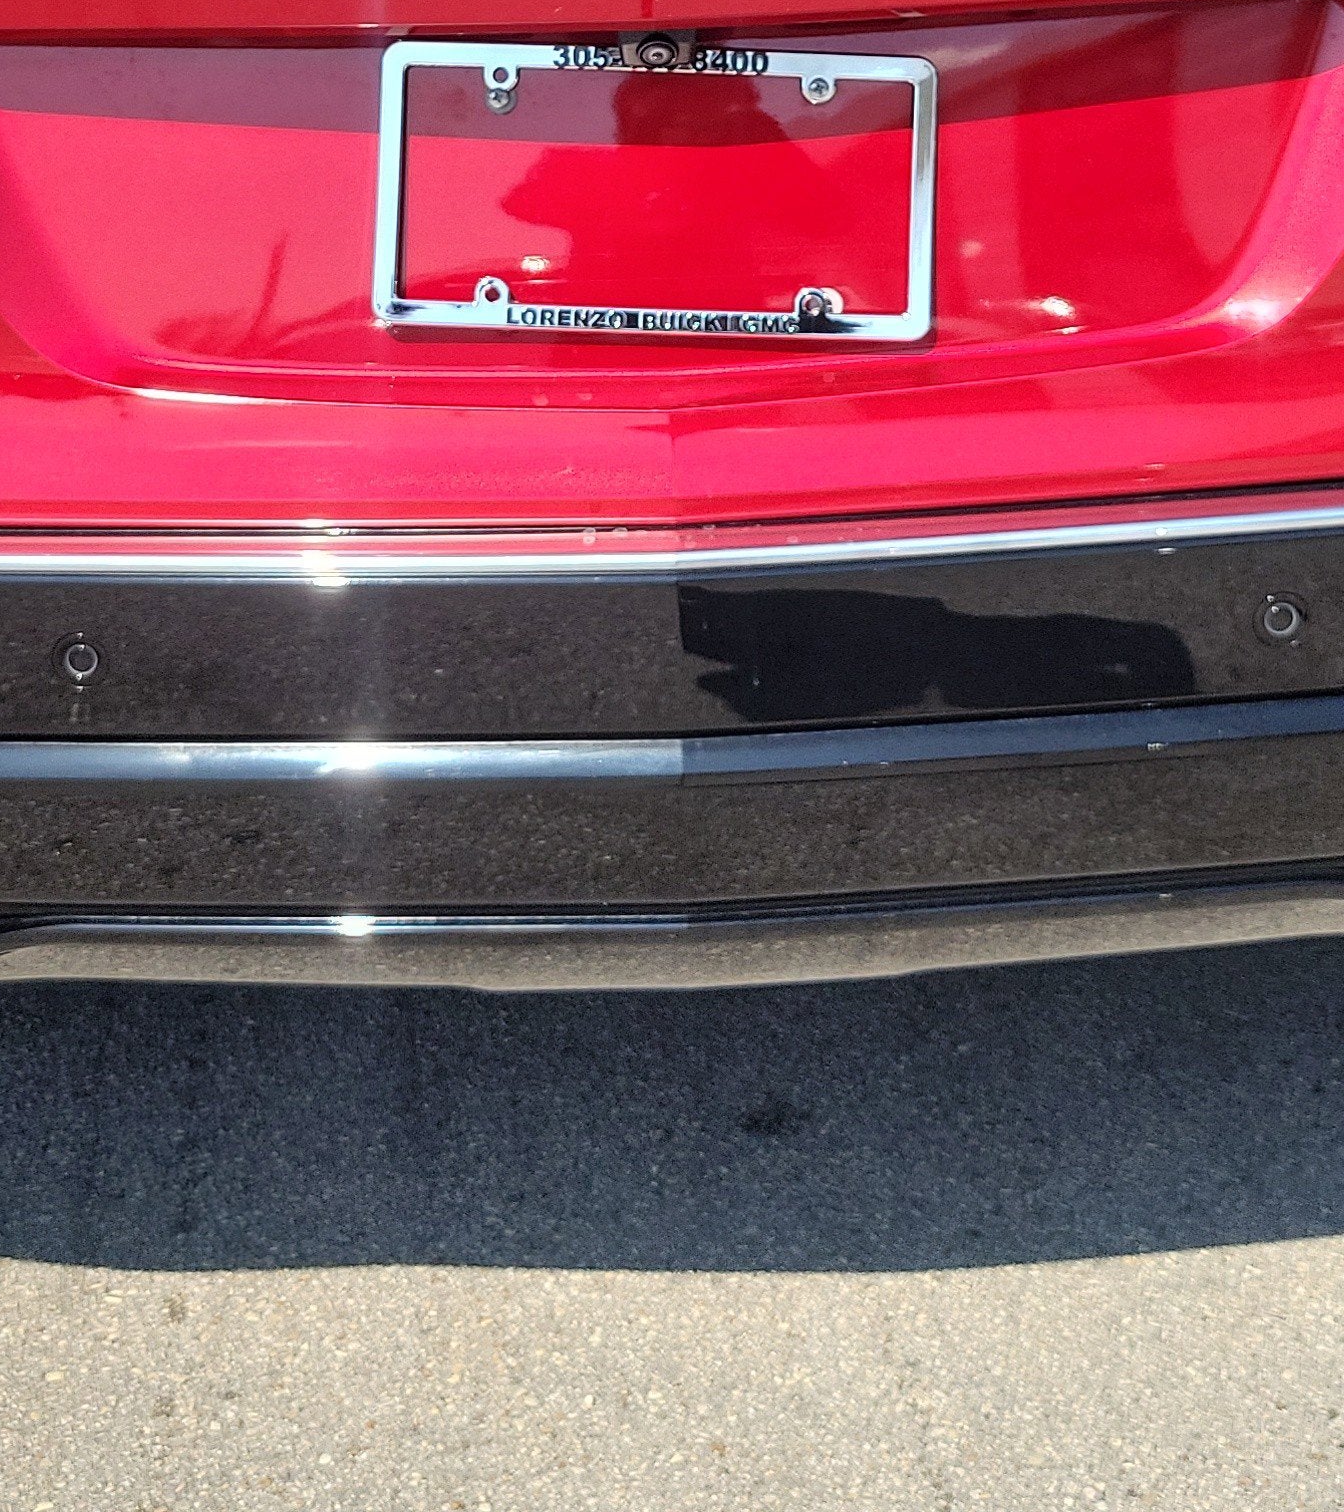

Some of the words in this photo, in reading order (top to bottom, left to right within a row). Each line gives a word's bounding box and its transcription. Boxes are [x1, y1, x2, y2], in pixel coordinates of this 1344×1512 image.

[506, 306, 627, 329] LORENZO
[640, 310, 723, 332] BUICK
[739, 313, 801, 334] GMC
